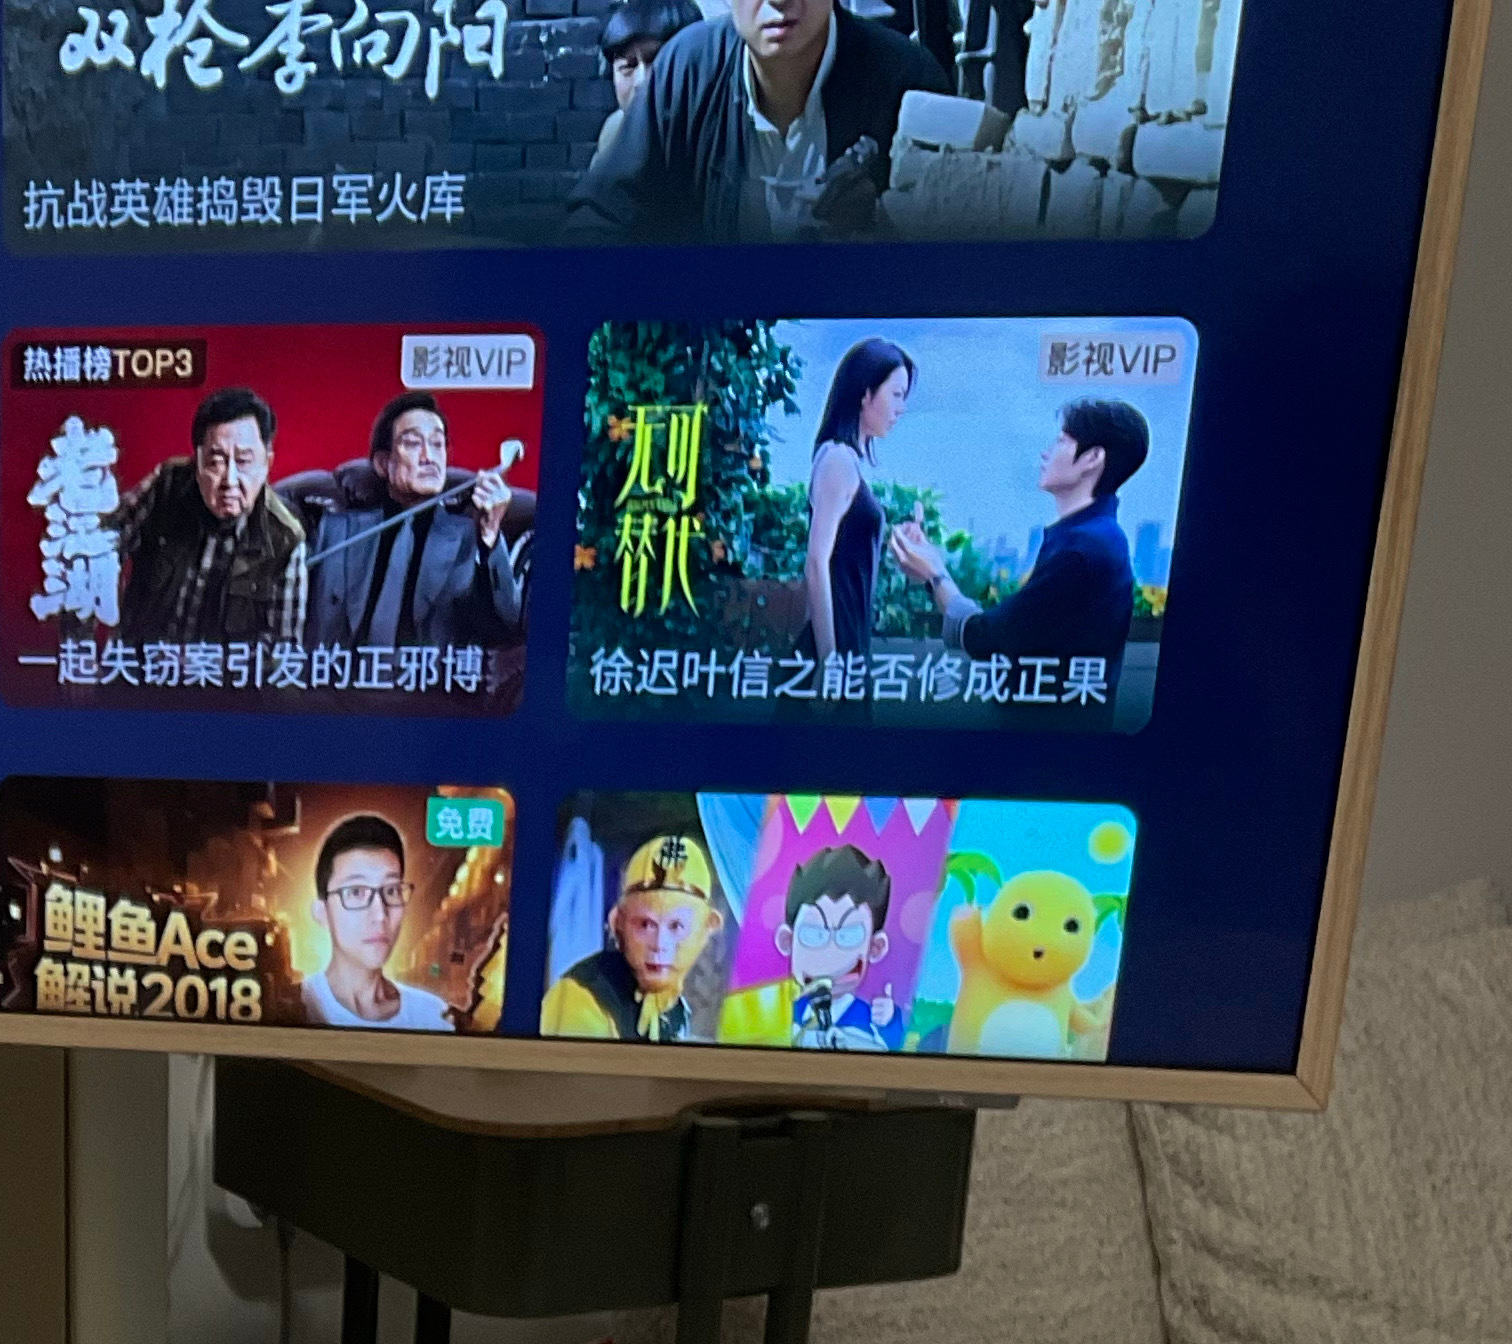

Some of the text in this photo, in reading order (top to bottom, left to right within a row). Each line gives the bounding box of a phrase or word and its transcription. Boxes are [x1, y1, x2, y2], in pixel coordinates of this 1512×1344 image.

[59, 0, 509, 100] 双枪李向阳
[22, 171, 467, 231] 抗战英雄捣毁日军火库
[22, 344, 194, 383] 热播榜TOP3
[411, 345, 528, 381] 影视VIP
[1047, 341, 1177, 377] 影视VIP
[17, 637, 485, 694] 一起失窃案引发的正邪博
[588, 645, 1109, 707] 徐迟叶信之能否修成正果
[434, 806, 495, 841] 免费
[43, 882, 259, 971] 鲤鱼Ace
[34, 956, 263, 1022] 解说2018
